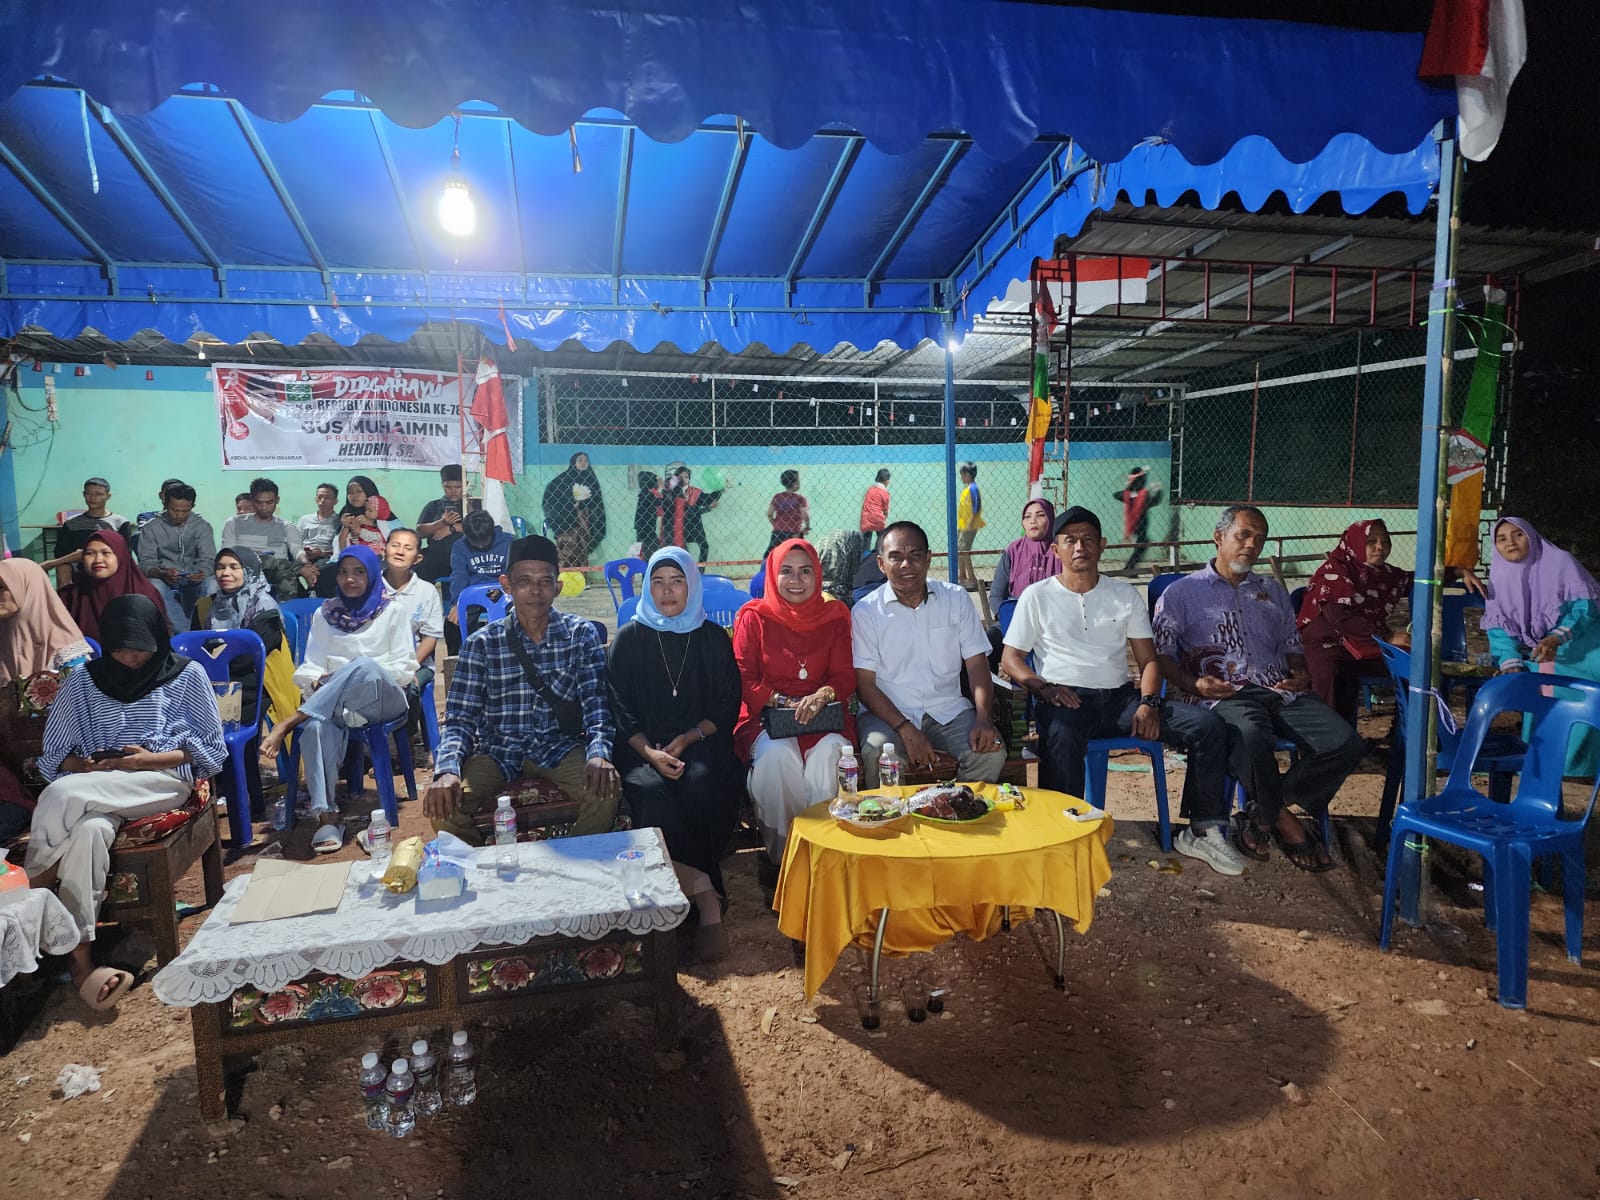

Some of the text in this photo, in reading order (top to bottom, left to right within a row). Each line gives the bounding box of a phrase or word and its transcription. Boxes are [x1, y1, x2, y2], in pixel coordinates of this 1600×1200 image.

[334, 376, 443, 399] DIRGAHAYU
[318, 399, 371, 411] REPUBLIK
[376, 400, 431, 414] INDONESIA
[301, 420, 448, 437] GUS MUHAIMIN
[470, 553, 505, 566] HOLIDAY
